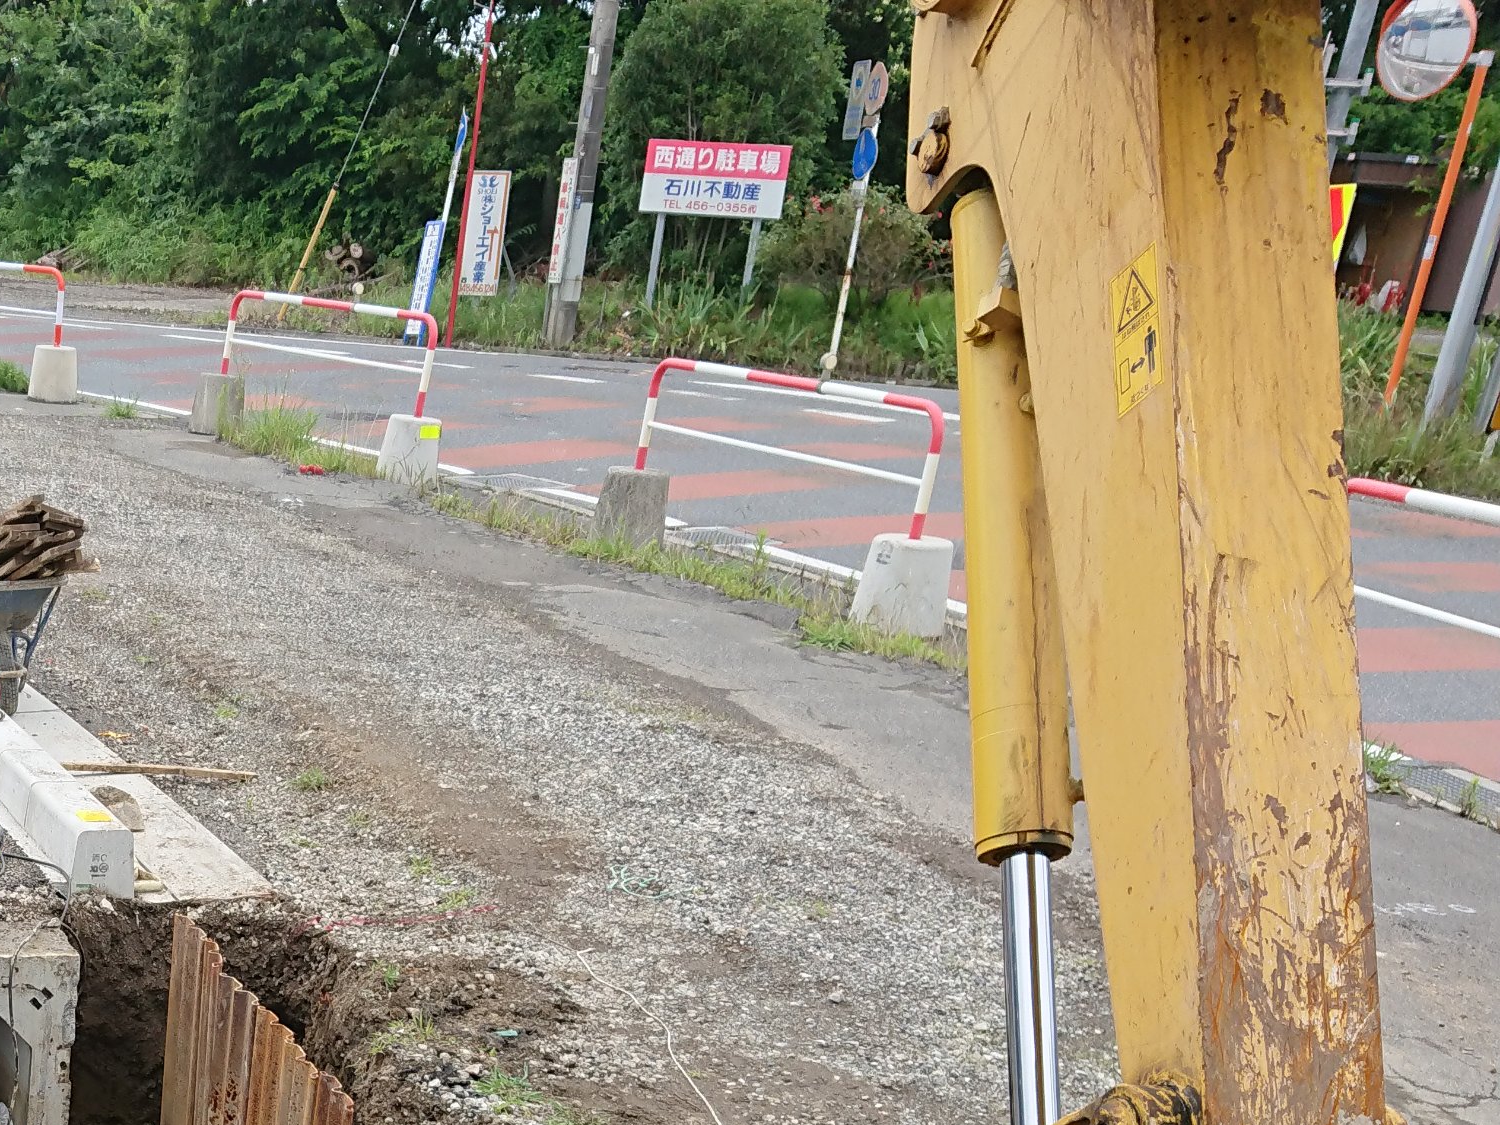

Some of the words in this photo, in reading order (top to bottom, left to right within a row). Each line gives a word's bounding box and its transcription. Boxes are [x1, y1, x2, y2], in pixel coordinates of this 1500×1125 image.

[869, 78, 881, 100] 30
[653, 145, 781, 174] 西通り駐車場
[664, 178, 762, 201] 石川不動産
[663, 199, 682, 209] TEL
